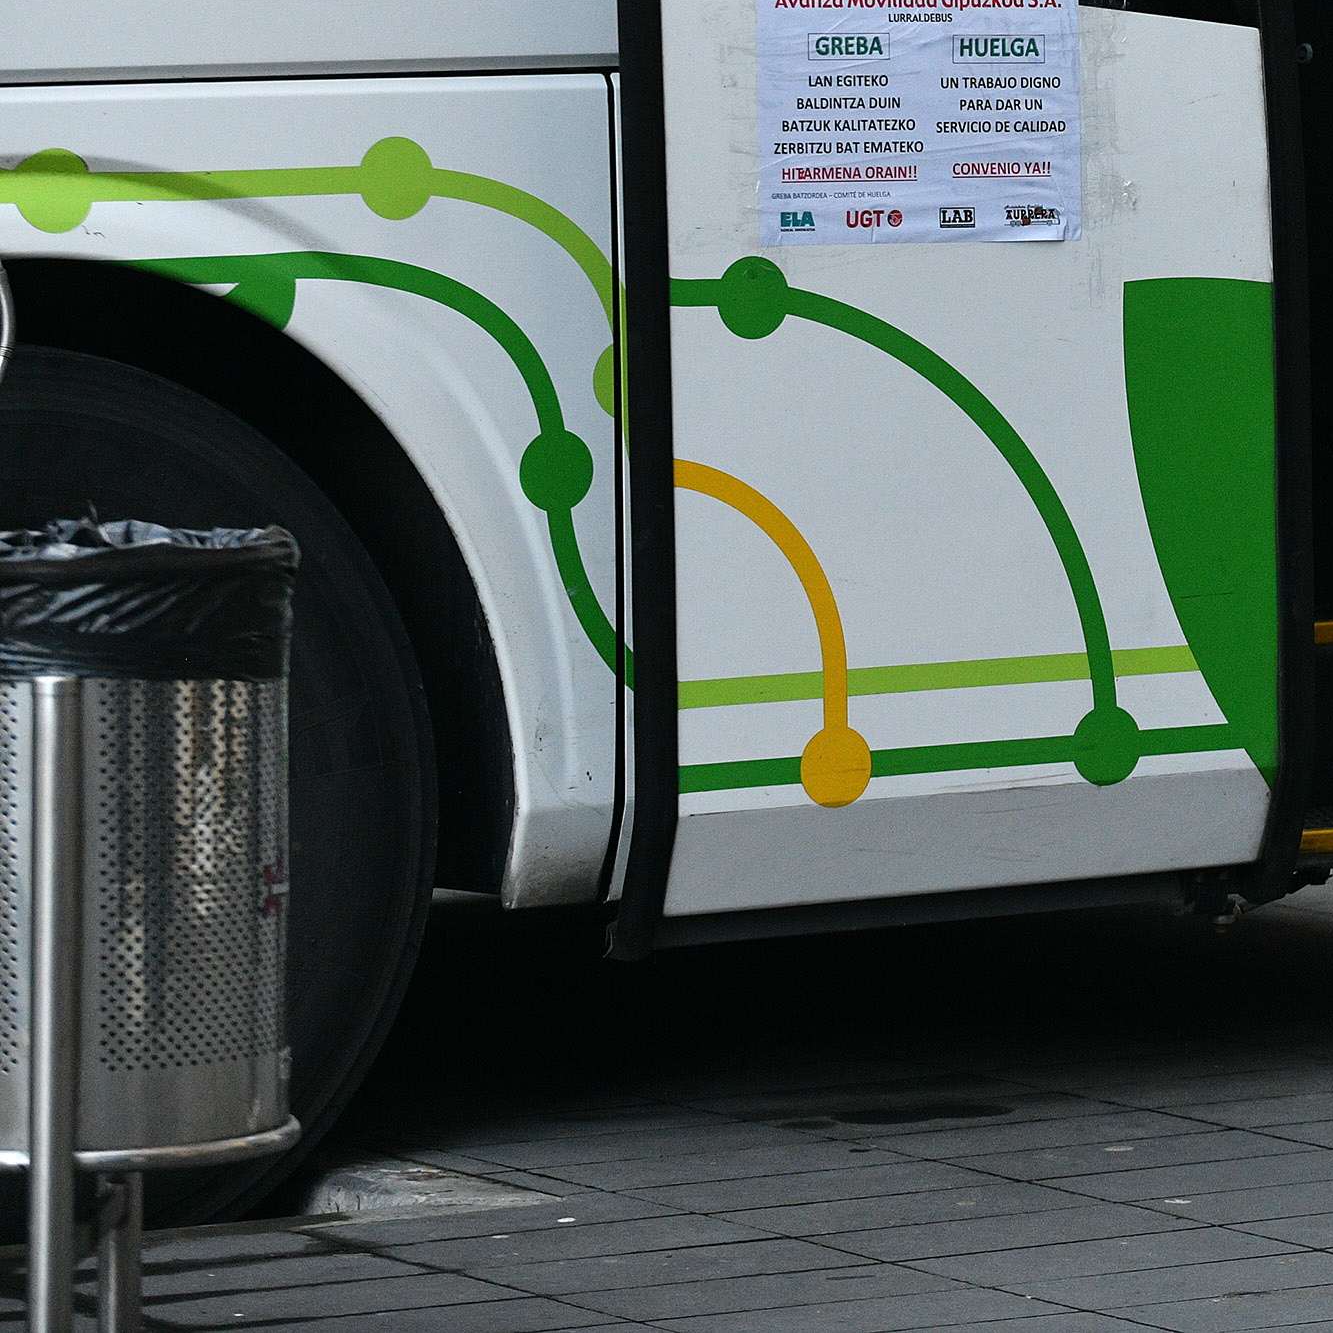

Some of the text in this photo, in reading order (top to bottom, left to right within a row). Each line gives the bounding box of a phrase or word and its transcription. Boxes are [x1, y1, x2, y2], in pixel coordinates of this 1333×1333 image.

[888, 13, 953, 23] LURRALDEBUS
[815, 36, 884, 56] GREBA
[959, 37, 1040, 57] HUELGA
[808, 74, 889, 87] LAN EGITEKO
[940, 76, 1061, 89] UN TRABAJO DIGNO
[796, 97, 901, 110] BALDINTZA DUIN
[959, 99, 1043, 111] PARA DAR UN
[782, 119, 916, 132] BATZUK KALITATEZKO
[936, 120, 1067, 133] SERVICIO DE CALIDAD
[774, 141, 924, 155] ZERBITZU BAT EMATEKO
[865, 165, 917, 179] ORAIN!!
[952, 162, 1051, 175] CONVENIO YA!!
[780, 211, 815, 227] ELA
[846, 209, 885, 228] UGT
[941, 209, 973, 223] LAB
